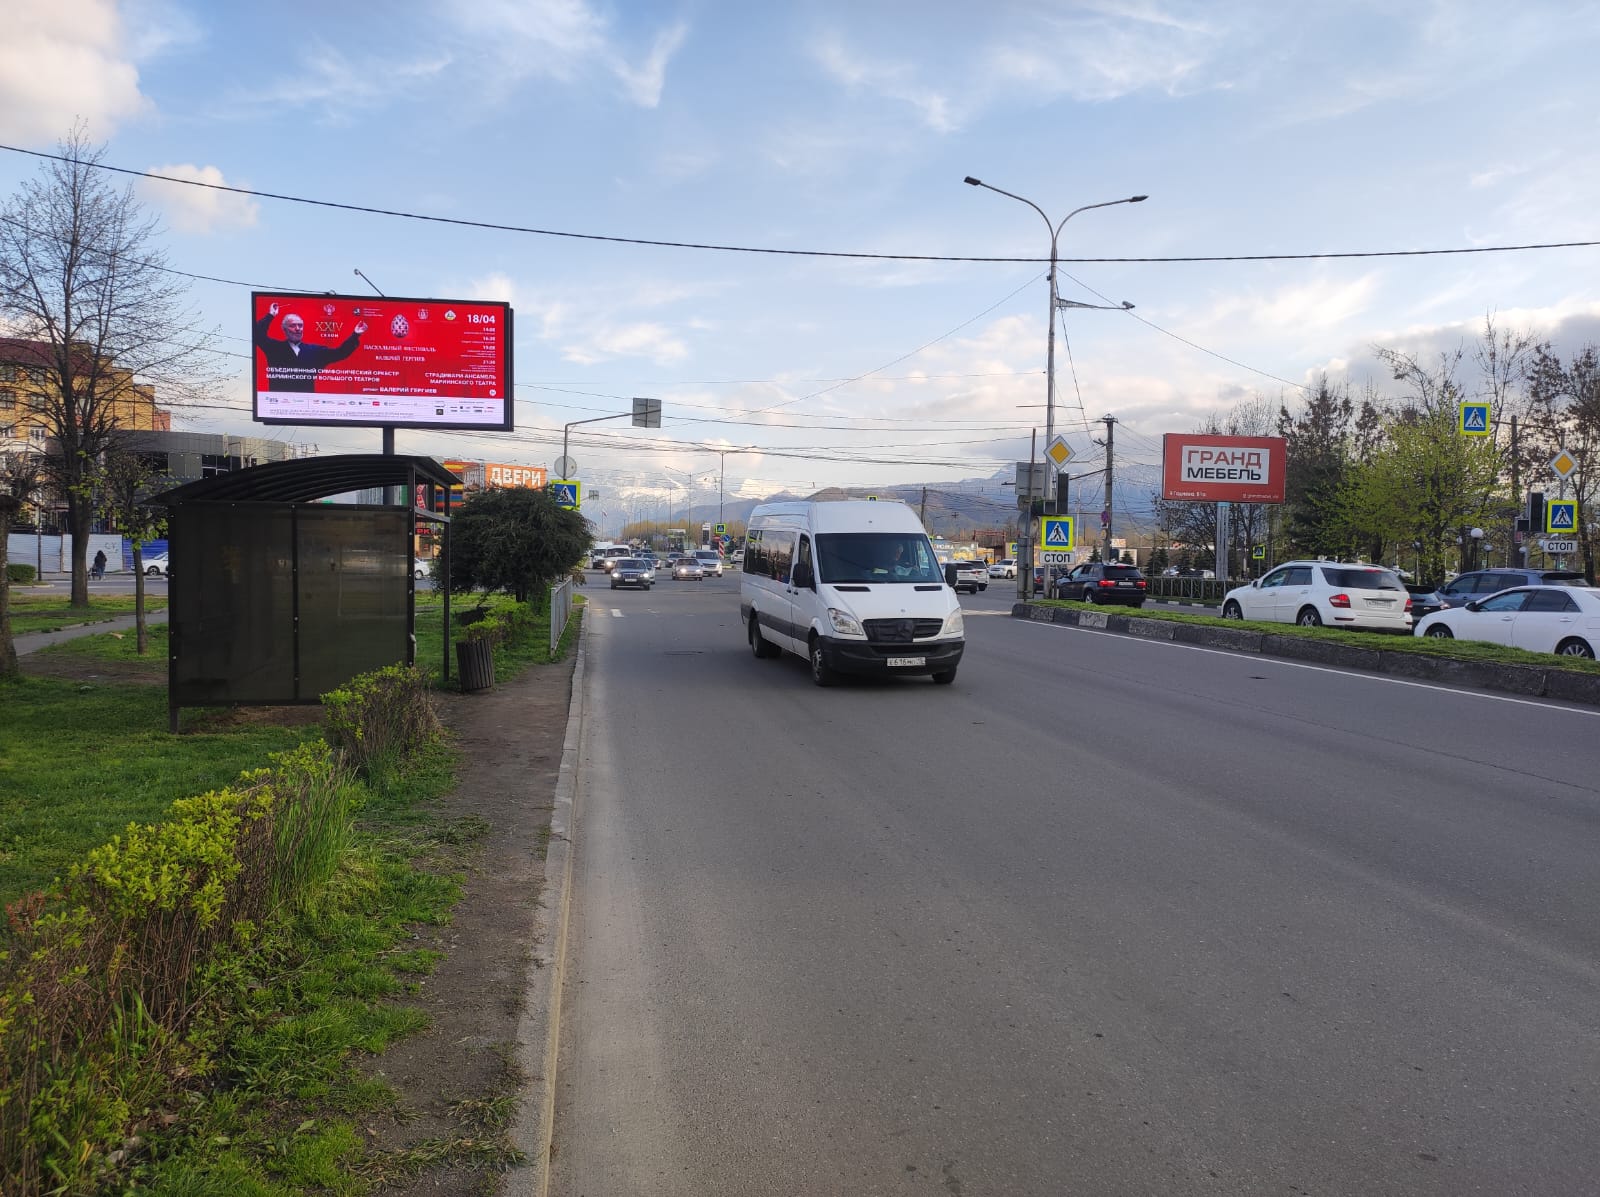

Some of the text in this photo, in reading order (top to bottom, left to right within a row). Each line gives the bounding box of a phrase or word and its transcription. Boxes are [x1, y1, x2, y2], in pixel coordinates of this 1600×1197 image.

[467, 314, 496, 324] 18/04
[315, 321, 343, 332] XXIV
[317, 368, 372, 376] СИМФОНИЧЕСКИЙ
[1187, 450, 1262, 470] ГРАНД
[490, 467, 541, 487] ДВЕРИ
[1187, 467, 1262, 481] МЕБЕЛЬ
[1548, 542, 1573, 551] СТОП
[1044, 553, 1070, 563] СТОП
